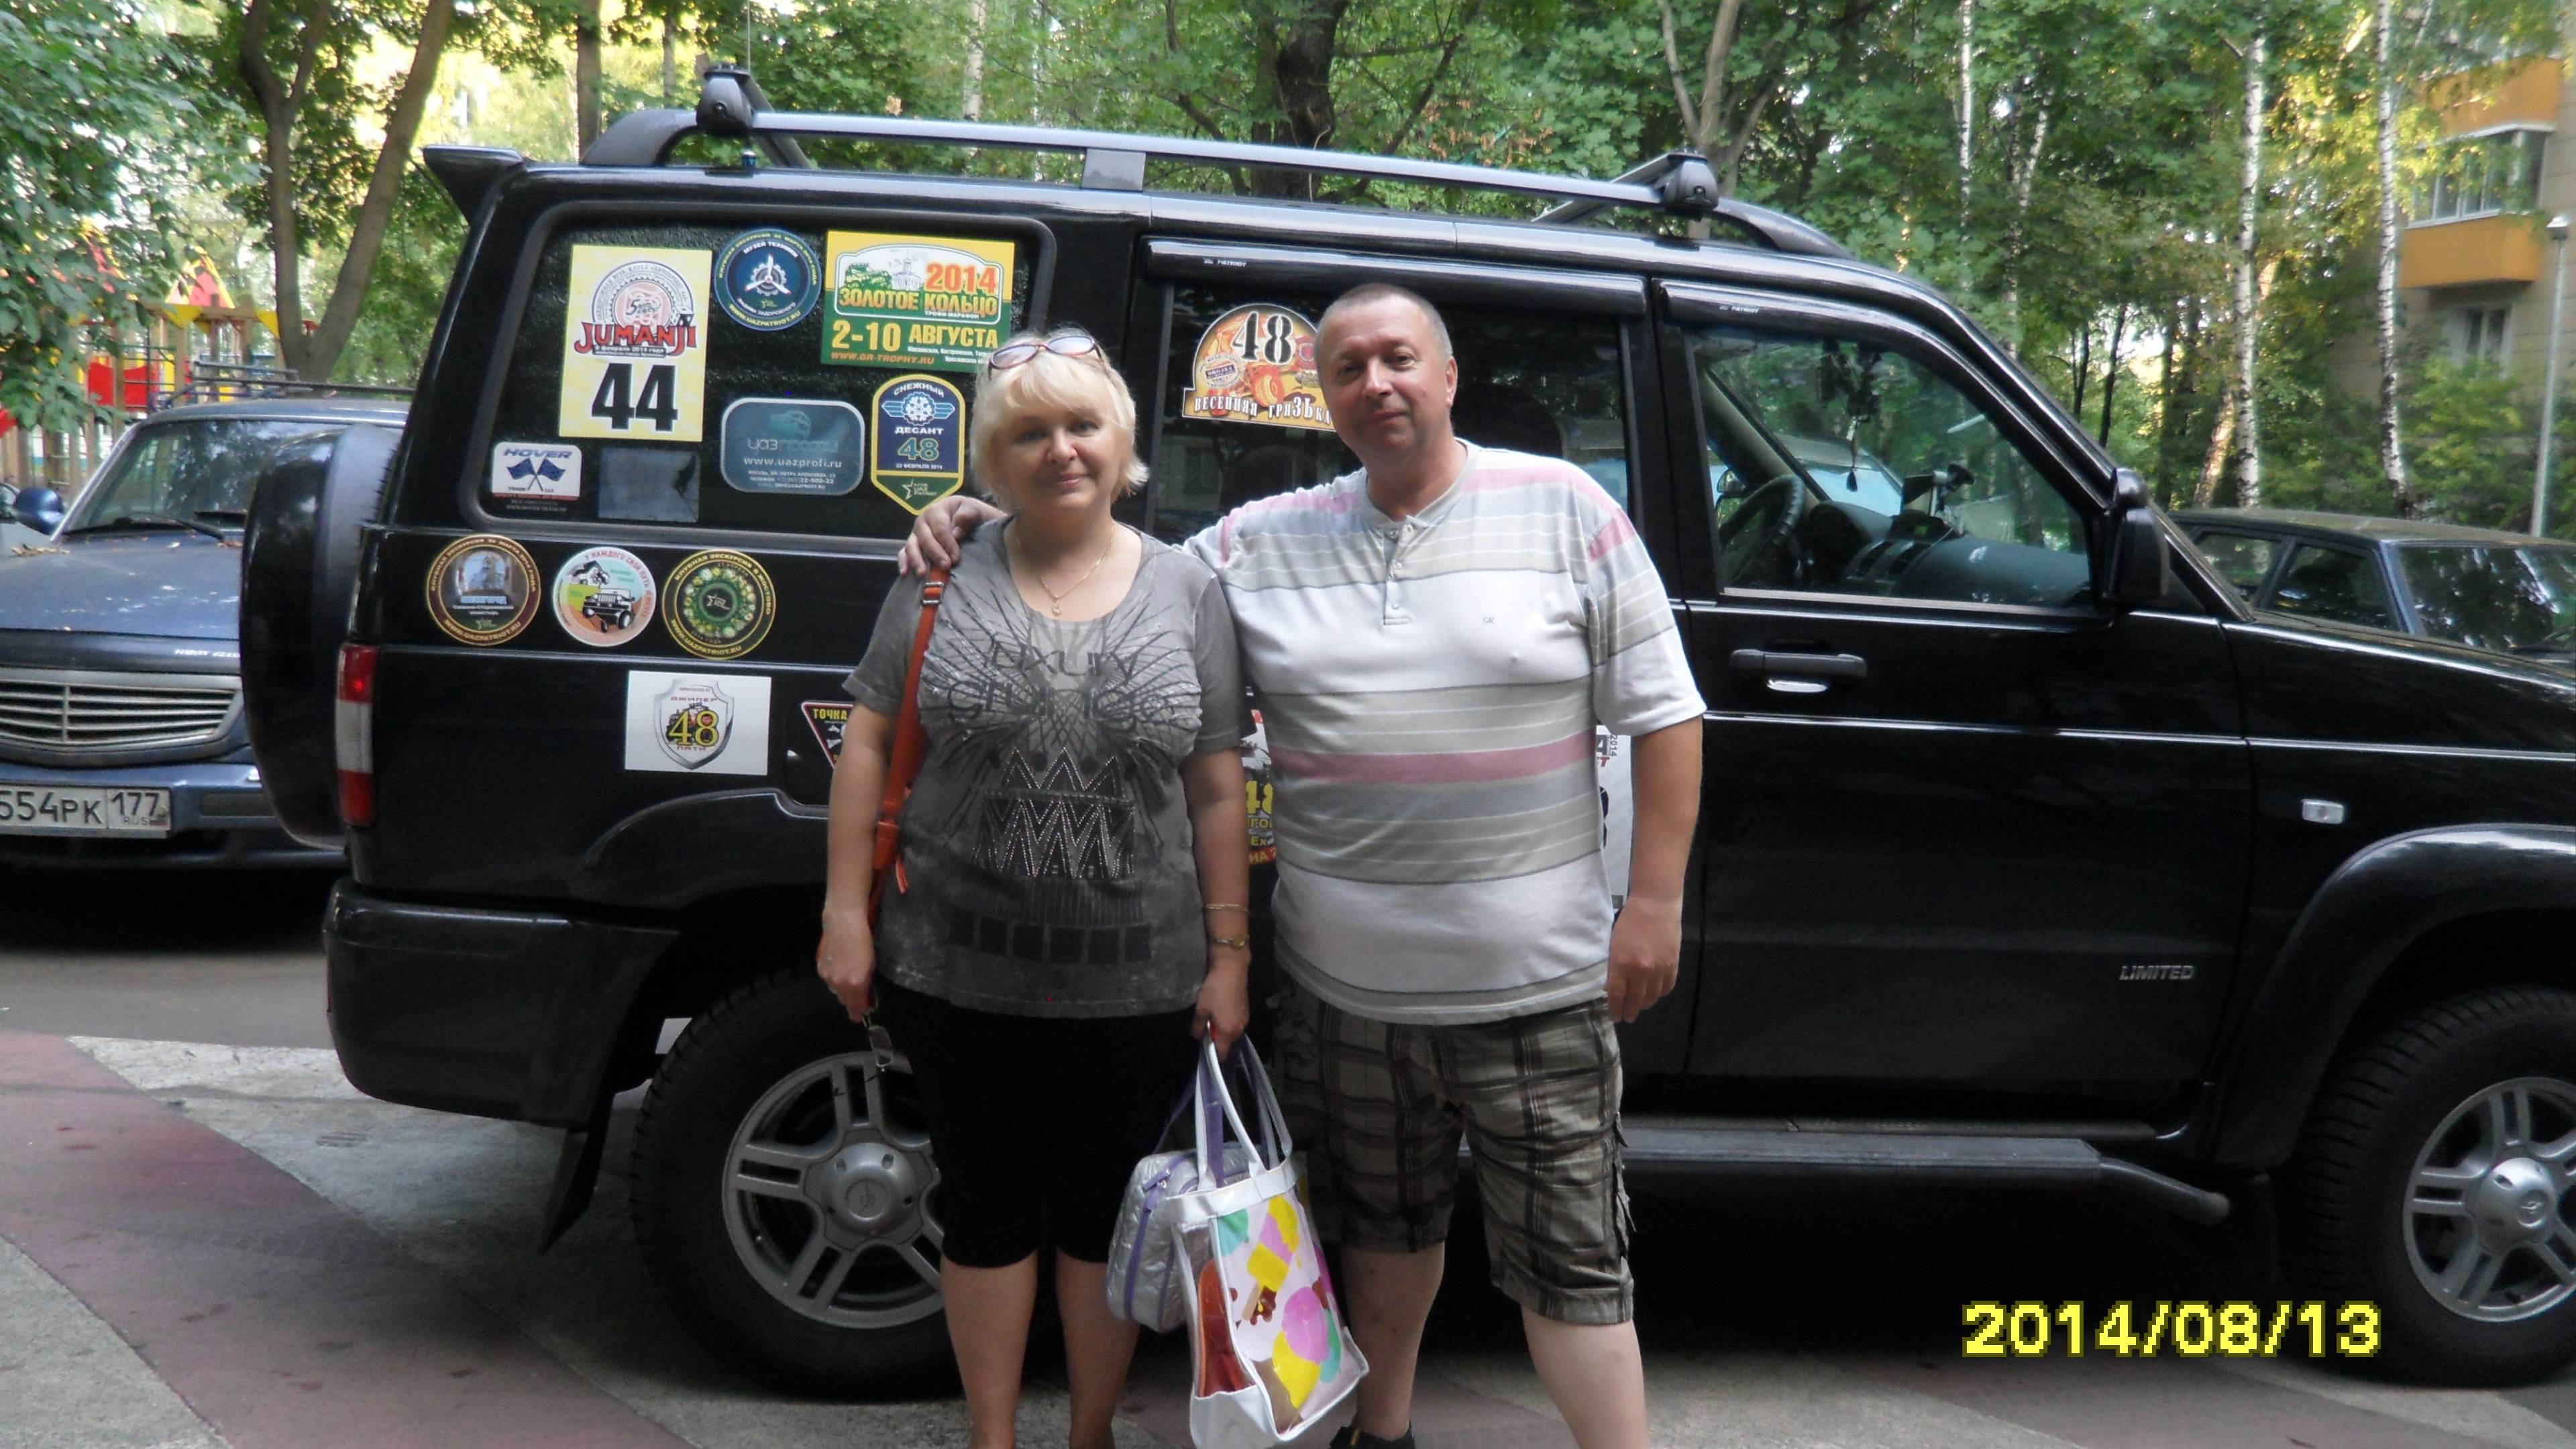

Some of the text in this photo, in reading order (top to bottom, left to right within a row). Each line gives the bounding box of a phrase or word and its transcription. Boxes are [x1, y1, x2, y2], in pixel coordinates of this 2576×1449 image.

[925, 262, 998, 295] 2014
[839, 287, 998, 318] ЗОЛОТОЕ КОЛЬЦО
[574, 322, 697, 356] JUMANJI
[832, 319, 998, 352] 2-10 АВГУСТА
[1230, 311, 1294, 366] 48
[591, 363, 678, 431] 44
[894, 382, 944, 398] СНЕЖНЫЙ
[1194, 396, 1258, 417] ВЕСЕННЯЯ
[895, 427, 943, 435] ДЕСАНТ
[503, 448, 573, 459] HOVER
[898, 437, 939, 461] 48
[743, 457, 842, 468] www.uazprofi.ru
[813, 708, 847, 720] ТОЧКА
[668, 710, 719, 747] 48
[111, 792, 160, 816] 177
[124, 816, 150, 825] RUS
[2119, 965, 2194, 980] LIMITED
